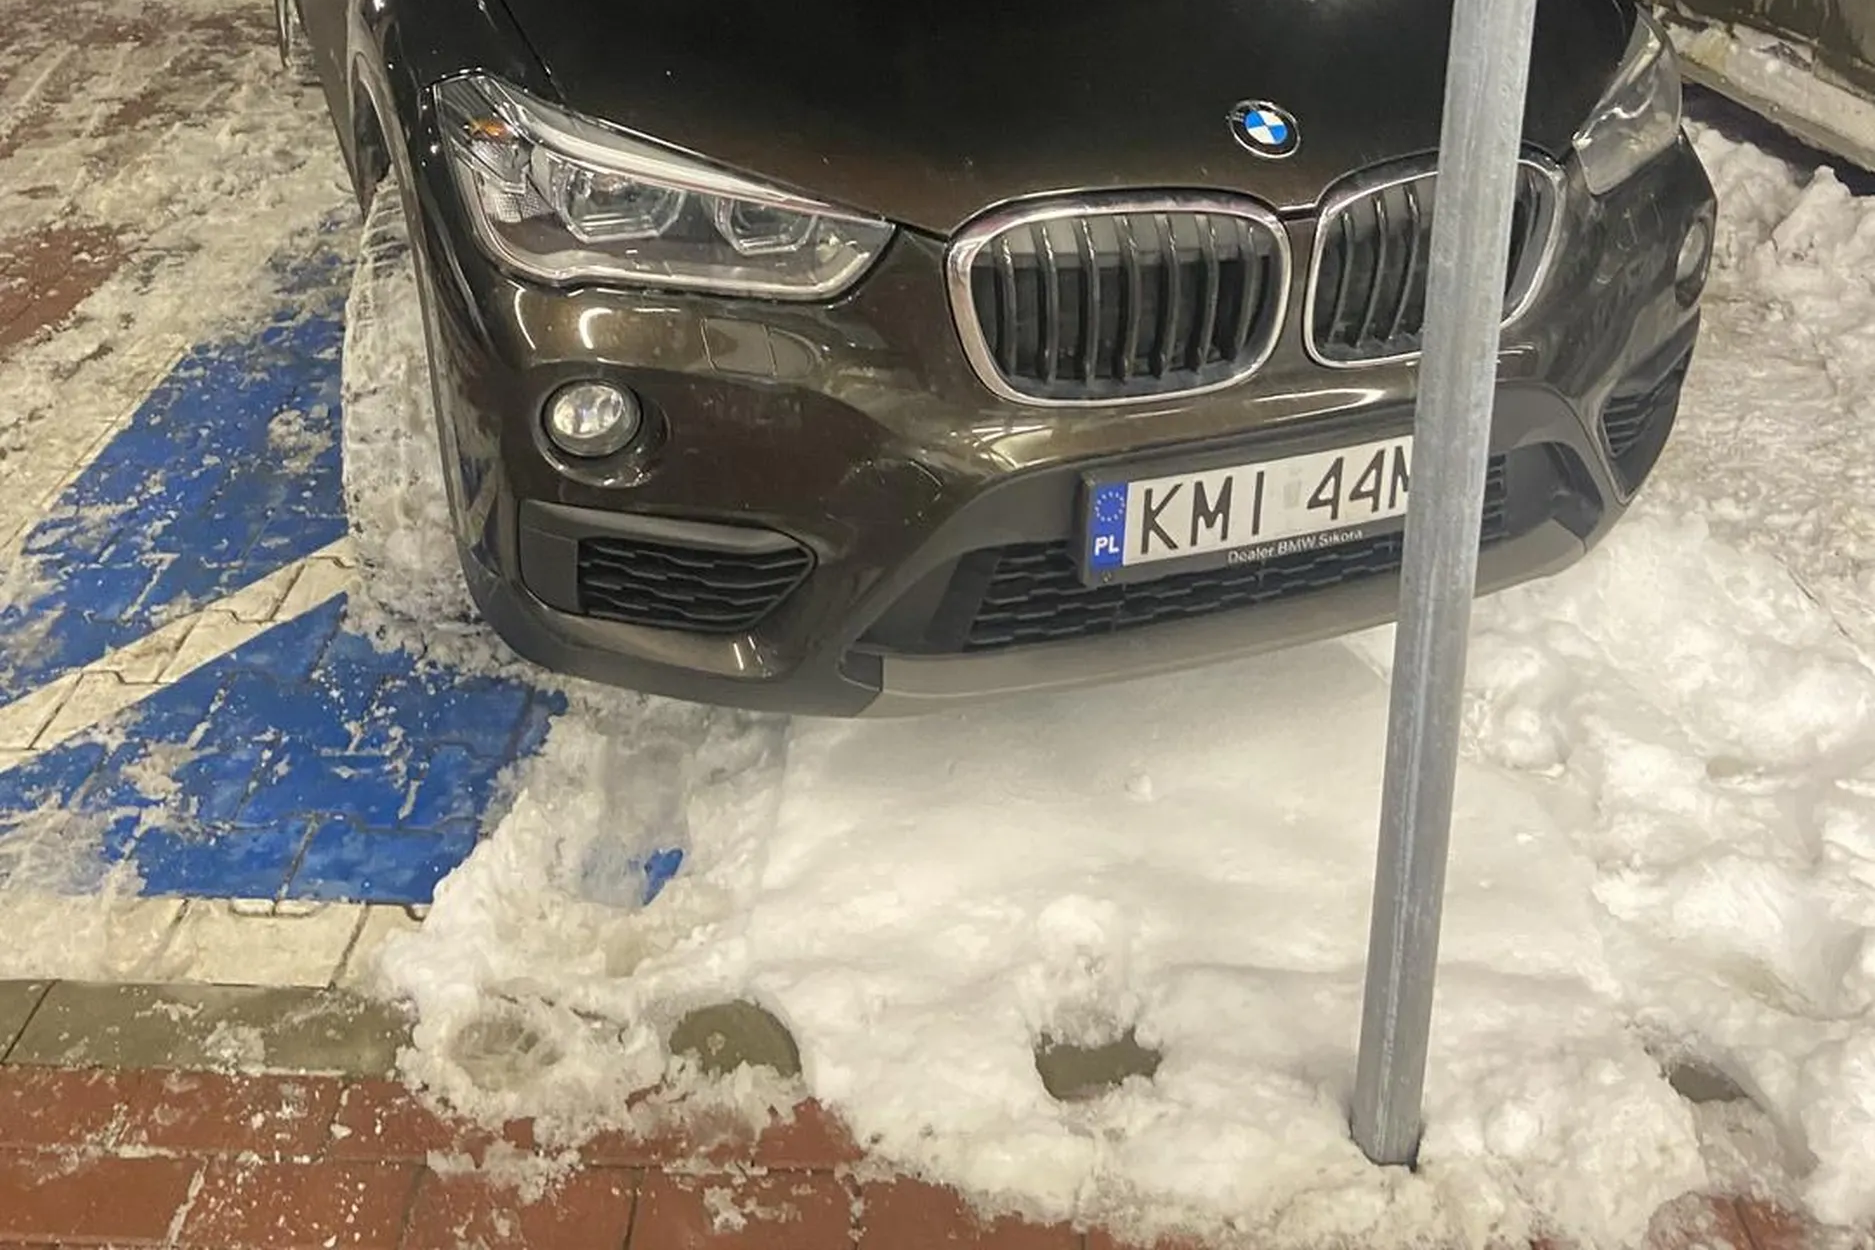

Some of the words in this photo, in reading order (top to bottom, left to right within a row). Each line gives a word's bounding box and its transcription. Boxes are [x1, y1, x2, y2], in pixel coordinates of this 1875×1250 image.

[1141, 470, 1265, 555] KMI
[1094, 534, 1120, 556] PL
[1228, 547, 1275, 564] Dealer
[1278, 536, 1317, 556] BMW
[1319, 529, 1363, 549] Sikora
